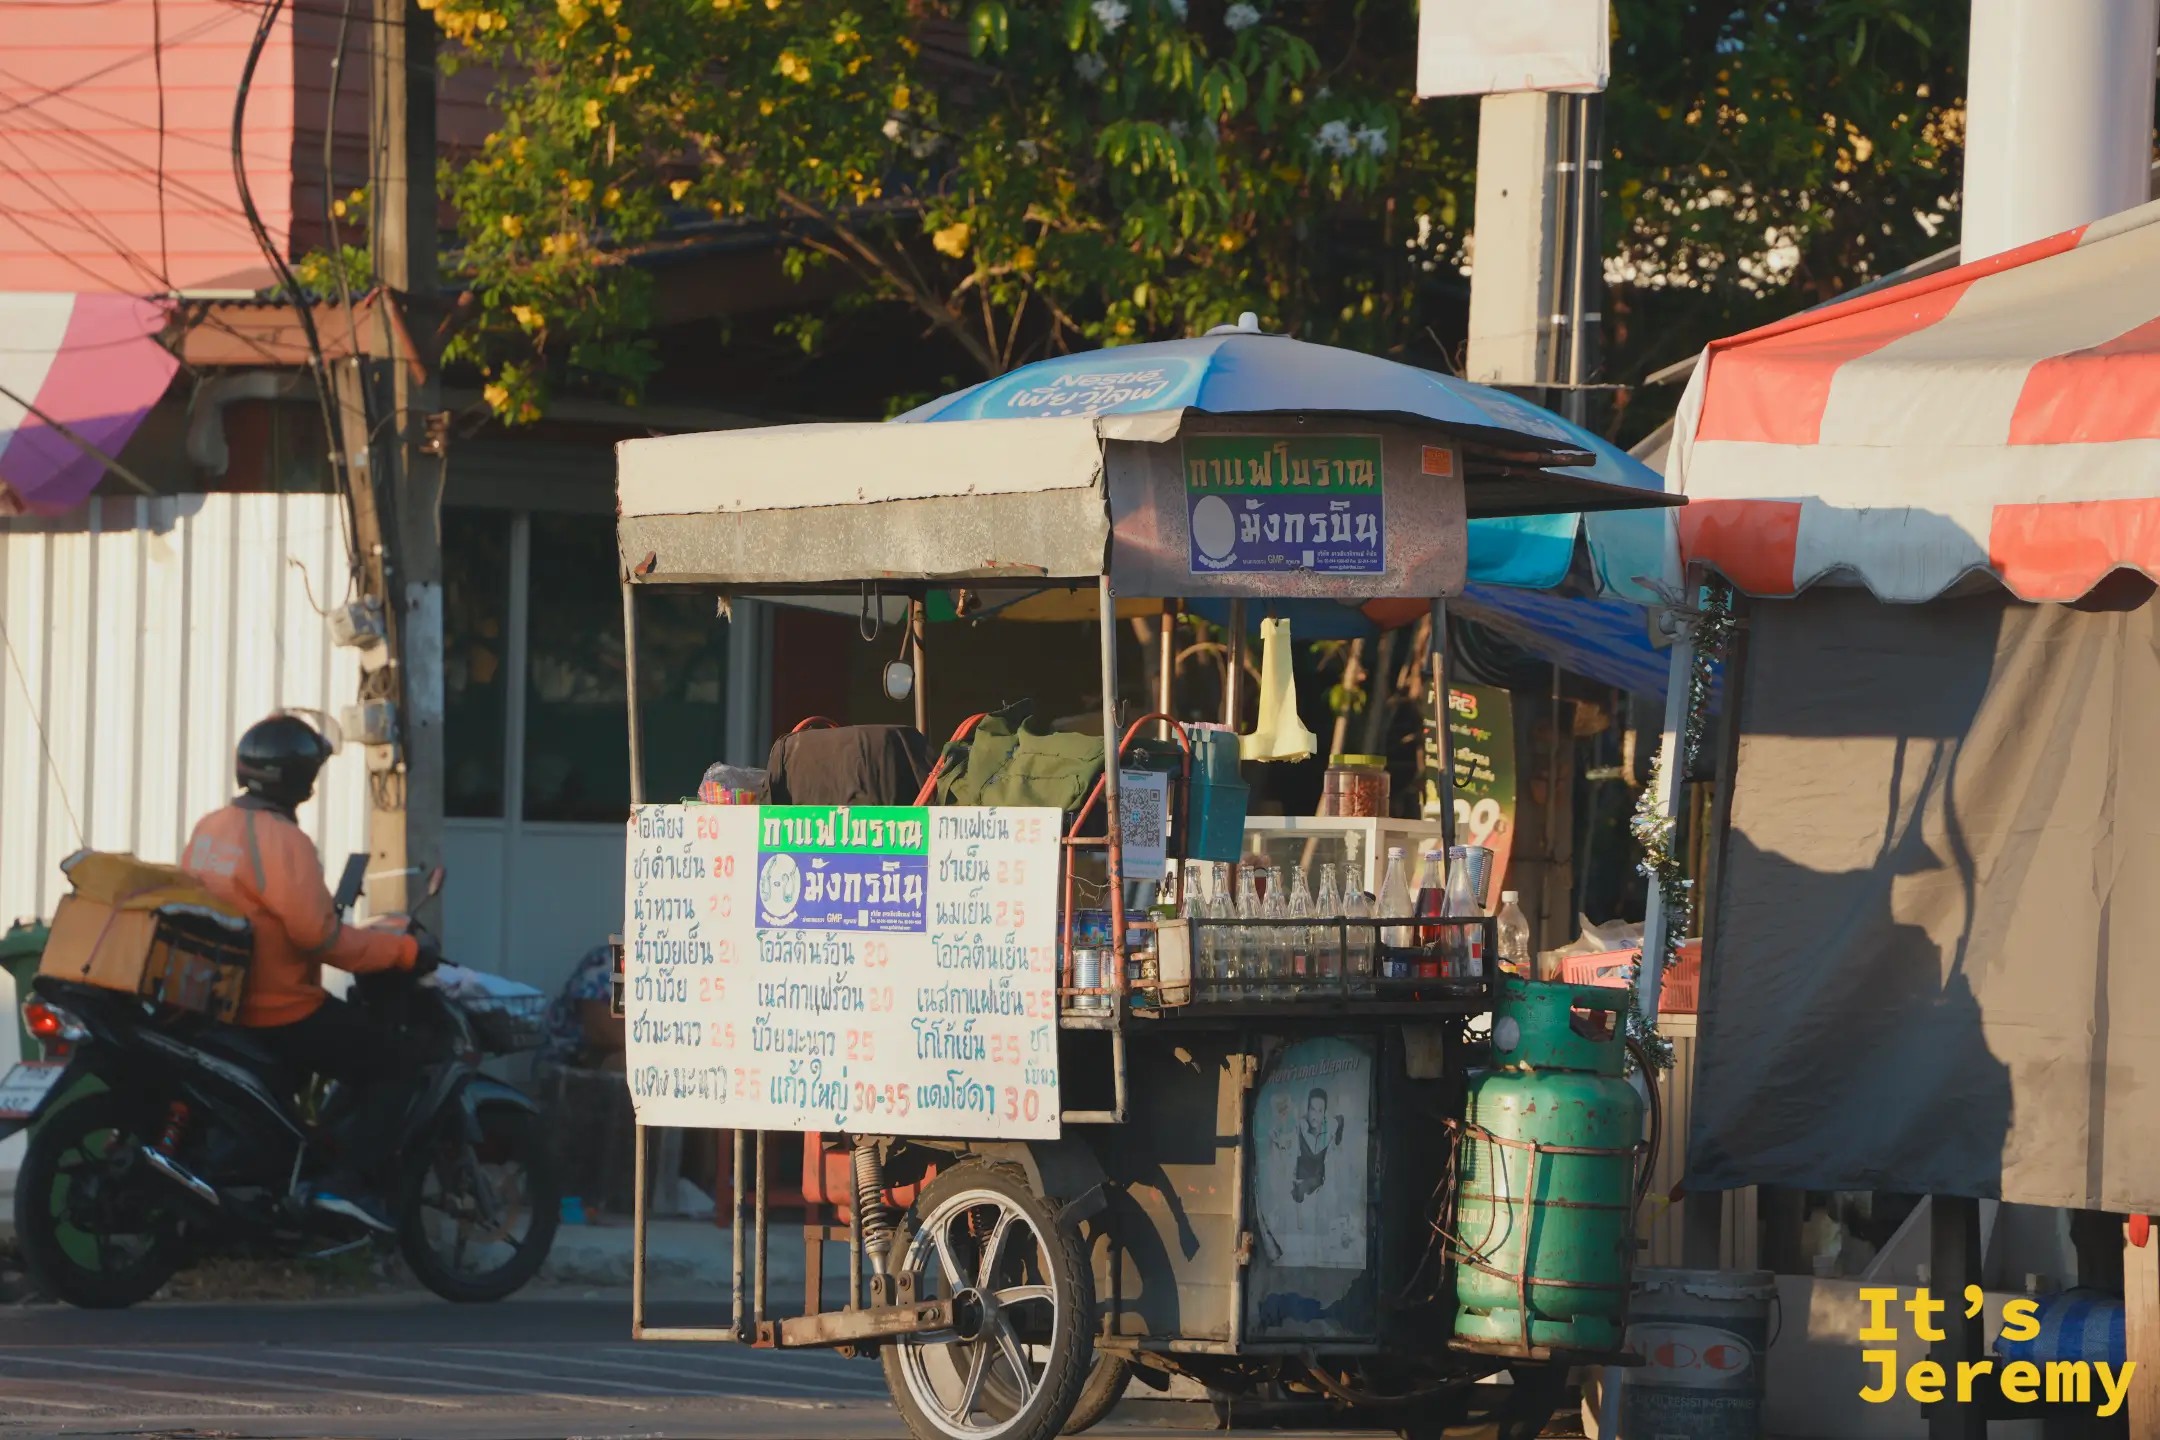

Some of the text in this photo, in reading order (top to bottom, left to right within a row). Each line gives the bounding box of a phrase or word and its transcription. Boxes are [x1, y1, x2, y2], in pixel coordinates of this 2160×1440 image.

[1189, 441, 1376, 488] กาแฟโบราณ
[1240, 499, 1378, 548] มังกรบิน
[1267, 555, 1284, 564] GMP
[697, 815, 719, 840] 20
[763, 807, 923, 850] กาแฟโบราณ
[939, 808, 1009, 840] กาแฟเย็น
[634, 842, 705, 879] ชาดำเย็น
[940, 844, 990, 882] ชาเย็น
[634, 881, 696, 921] น้ำหวาน
[804, 857, 923, 909] มังกรบิน
[826, 913, 843, 923] GMP
[936, 886, 1025, 927] นมเย็น 25
[864, 941, 889, 967] 20
[1029, 946, 1053, 973] 25
[699, 977, 726, 1002] 25
[758, 971, 894, 1014] เนสกาแฟร้อน 20
[917, 975, 1024, 1015] เนสกาแฟเย็น
[633, 1008, 736, 1048] ชามะนาว 25
[846, 1029, 874, 1061] 25
[911, 1017, 1021, 1065] โกโก้เย็น 25
[1030, 1025, 1050, 1052] ชา
[734, 1067, 761, 1099] 25
[853, 1081, 911, 1117] 30-35
[917, 1069, 1040, 1122] แดงโซดา 30
